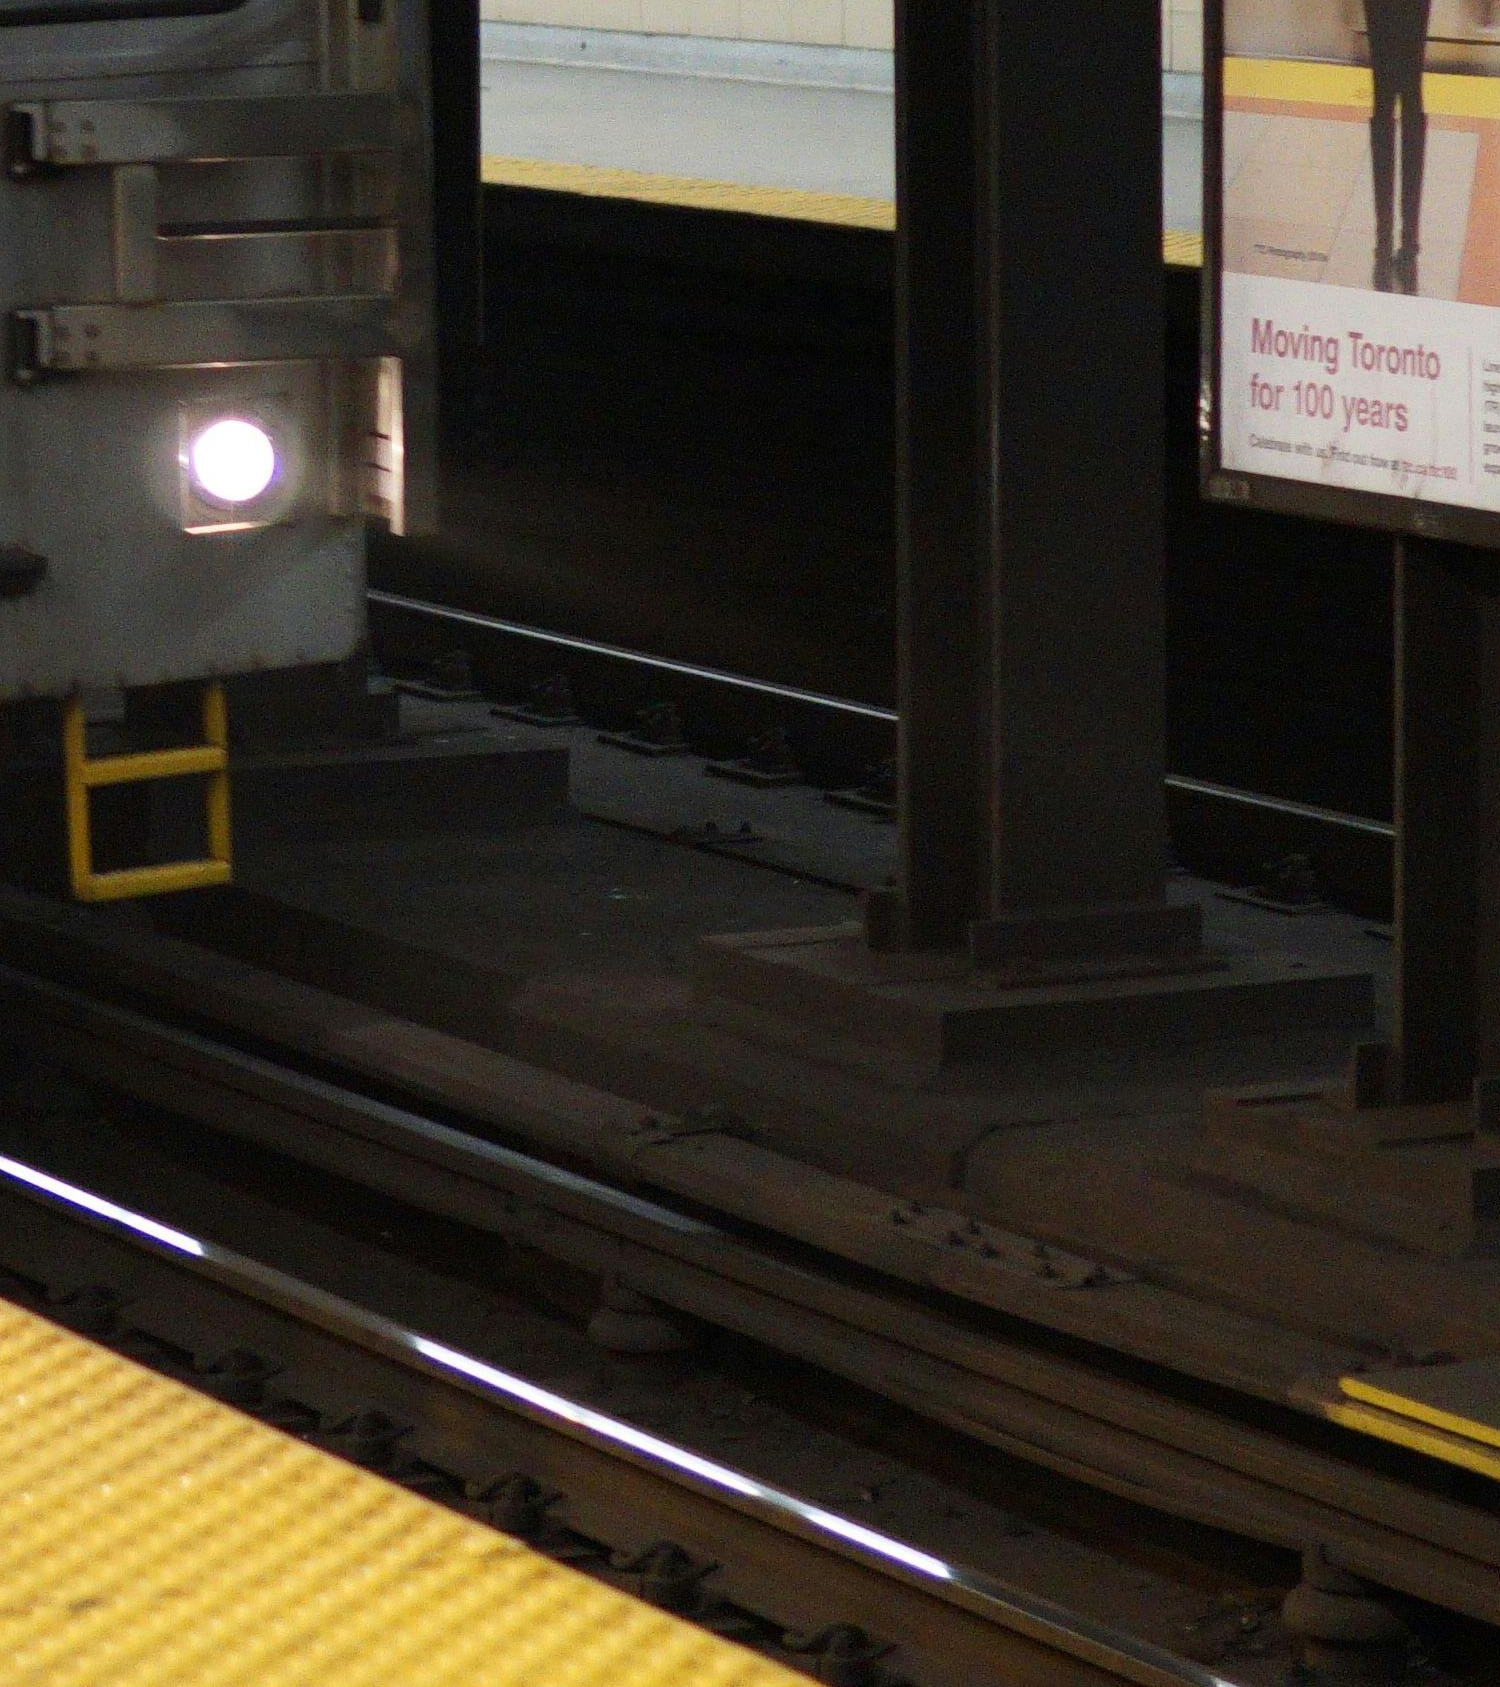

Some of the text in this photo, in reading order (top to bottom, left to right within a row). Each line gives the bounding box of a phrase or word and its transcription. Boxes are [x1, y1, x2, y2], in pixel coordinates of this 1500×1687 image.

[1251, 317, 1441, 381] Moving Toronto
[1249, 372, 1409, 433] for 100 years
